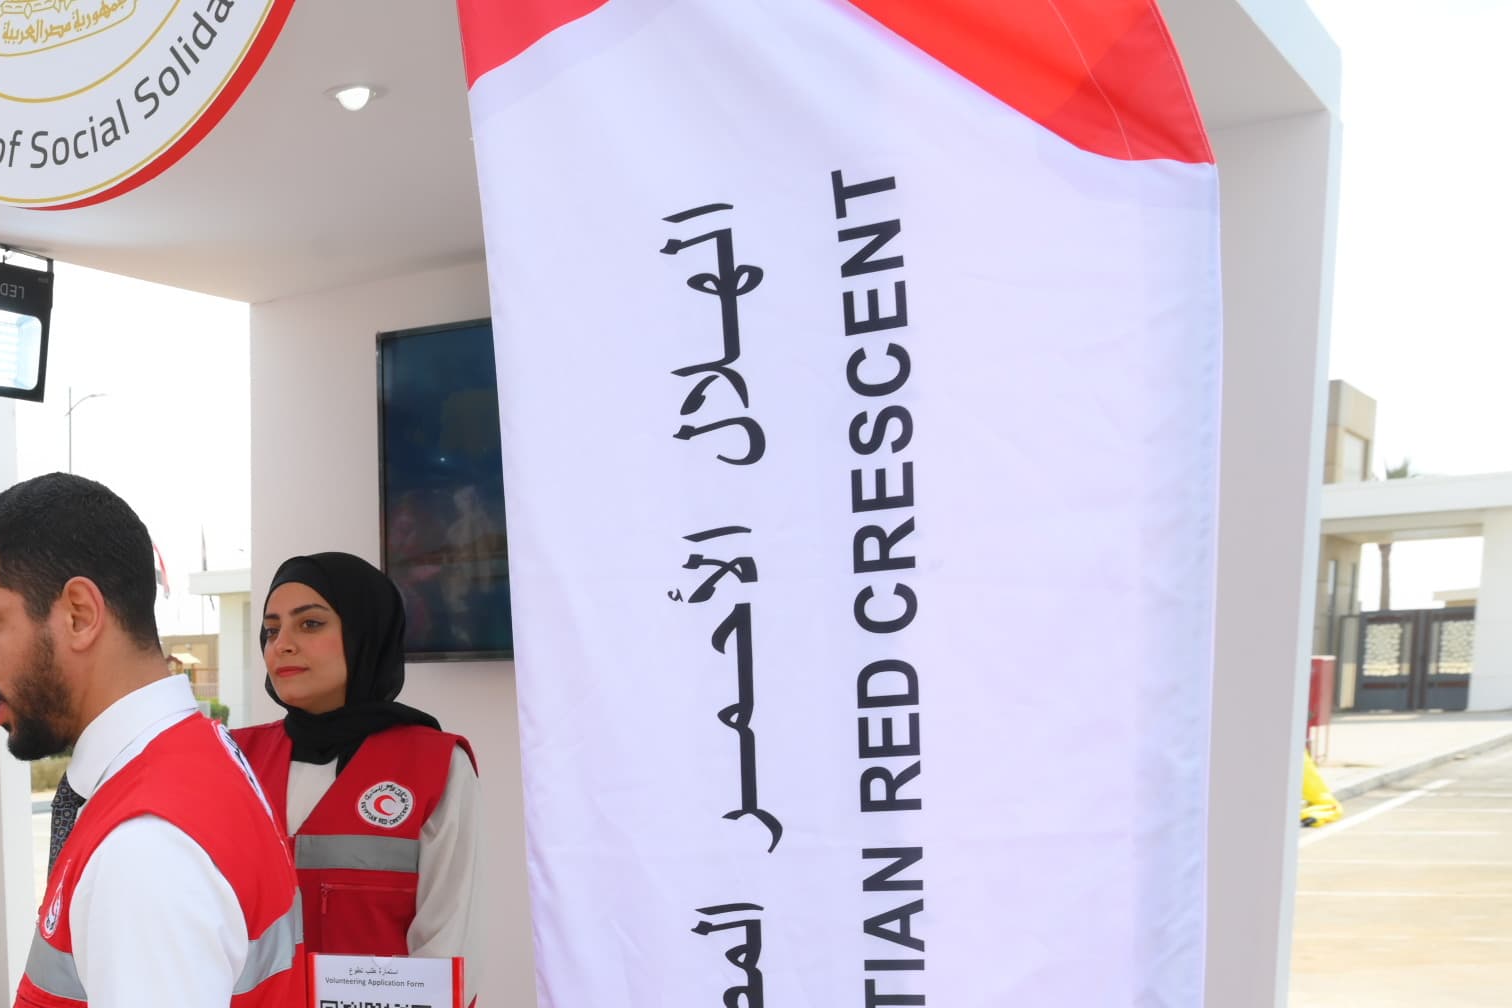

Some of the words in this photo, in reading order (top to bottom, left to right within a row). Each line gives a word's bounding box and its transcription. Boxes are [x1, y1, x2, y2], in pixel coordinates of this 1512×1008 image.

[29, 99, 131, 169] Social
[0, 282, 25, 300] LED
[659, 201, 766, 466] الهلال
[831, 168, 919, 634] CRESCENT
[667, 524, 783, 854] الأحمر
[856, 658, 923, 813] RED
[325, 977, 367, 987] Volunteering
[368, 978, 405, 988] Application
